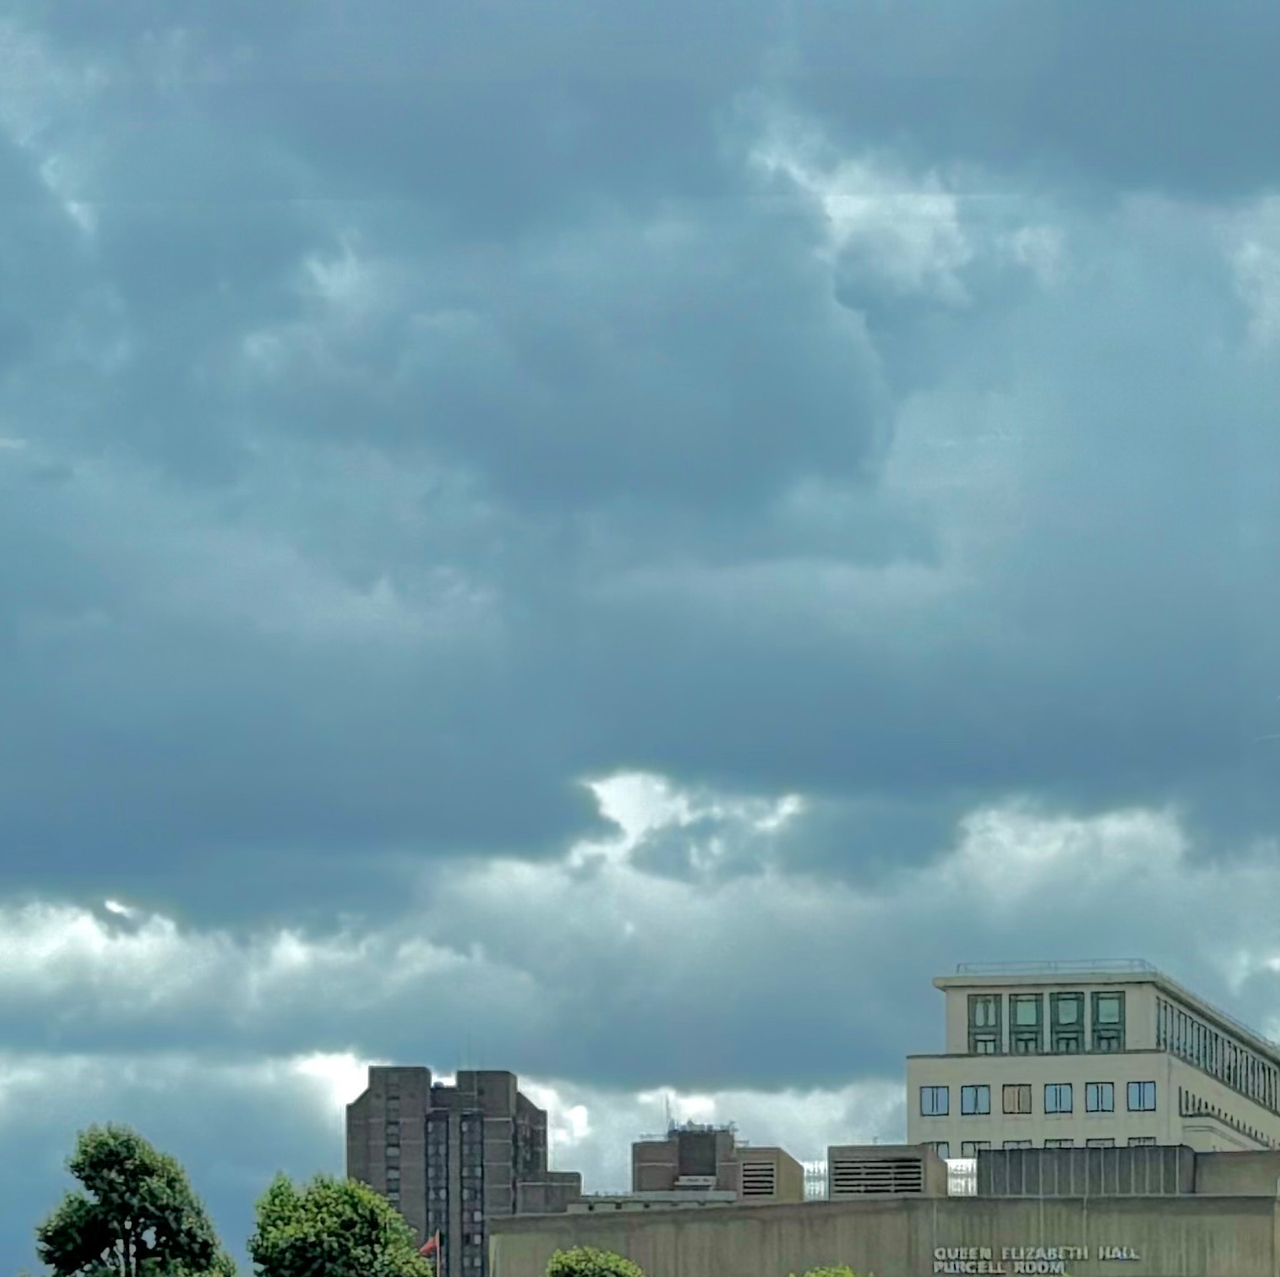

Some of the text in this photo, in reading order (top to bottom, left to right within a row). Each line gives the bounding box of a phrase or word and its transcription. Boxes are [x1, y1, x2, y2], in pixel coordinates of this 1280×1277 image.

[934, 1246, 1140, 1260] QUEEN ELIZABETH HALL
[933, 1260, 1065, 1274] PURCELL ROOM
